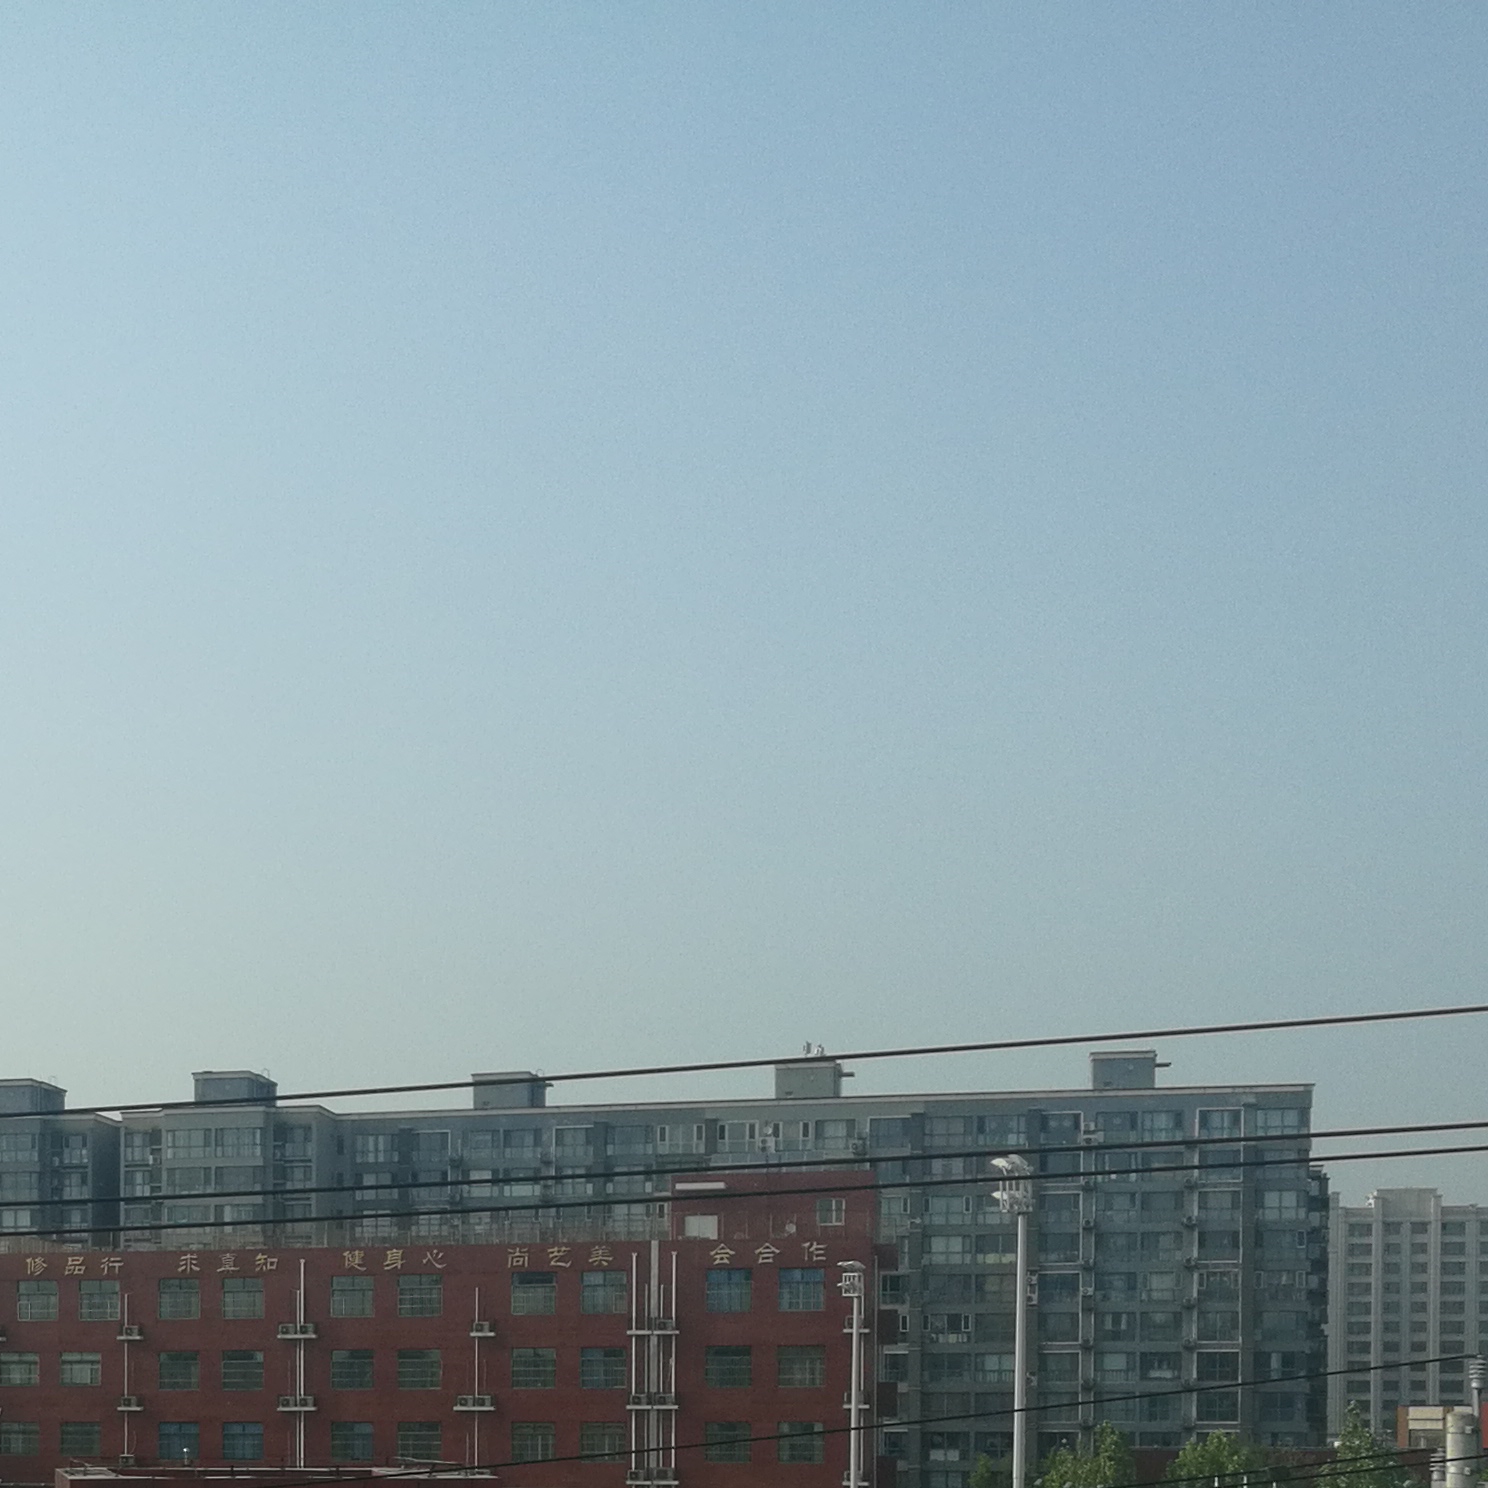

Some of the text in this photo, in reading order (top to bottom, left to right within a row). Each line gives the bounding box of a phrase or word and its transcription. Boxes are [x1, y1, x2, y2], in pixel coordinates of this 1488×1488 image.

[25, 1241, 829, 1277] 修品行 求真知 健身心 尚艺美 会合作
